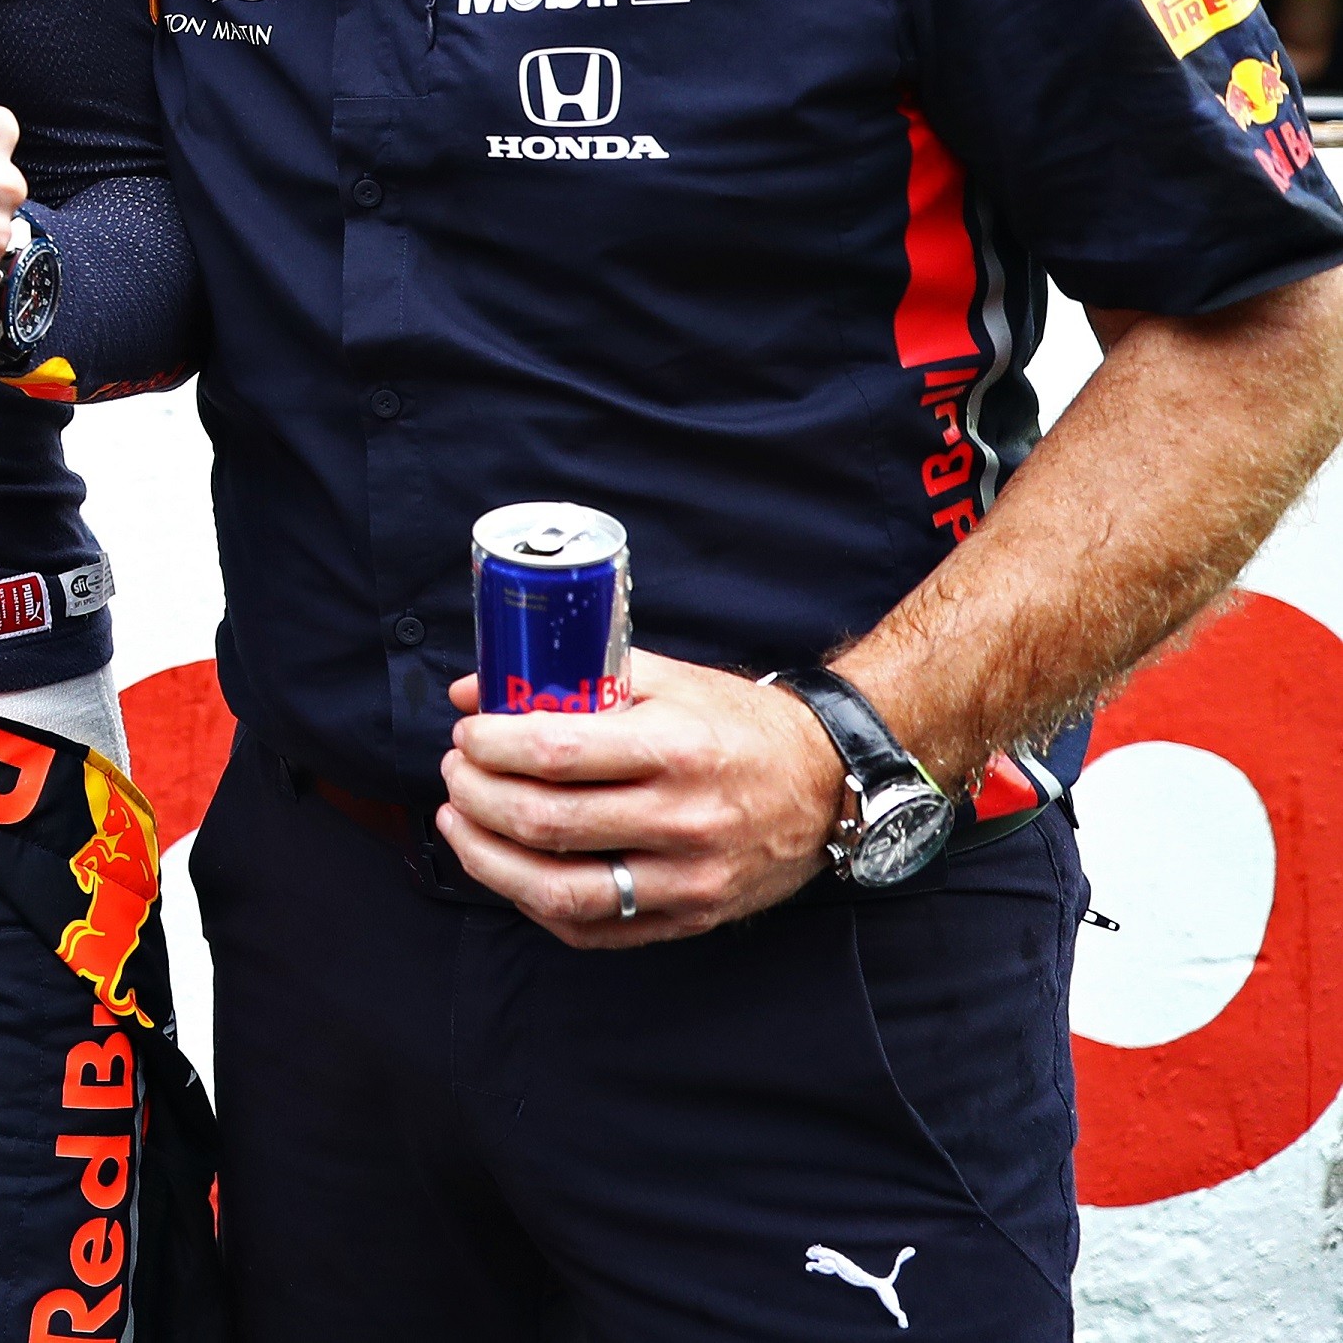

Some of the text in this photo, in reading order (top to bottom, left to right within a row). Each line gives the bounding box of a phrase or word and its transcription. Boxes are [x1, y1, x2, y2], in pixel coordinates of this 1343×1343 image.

[487, 135, 669, 160] HONDA
[21, 583, 34, 616] PUMA
[506, 674, 591, 713] Red
[29, 1135, 132, 1343] Red
